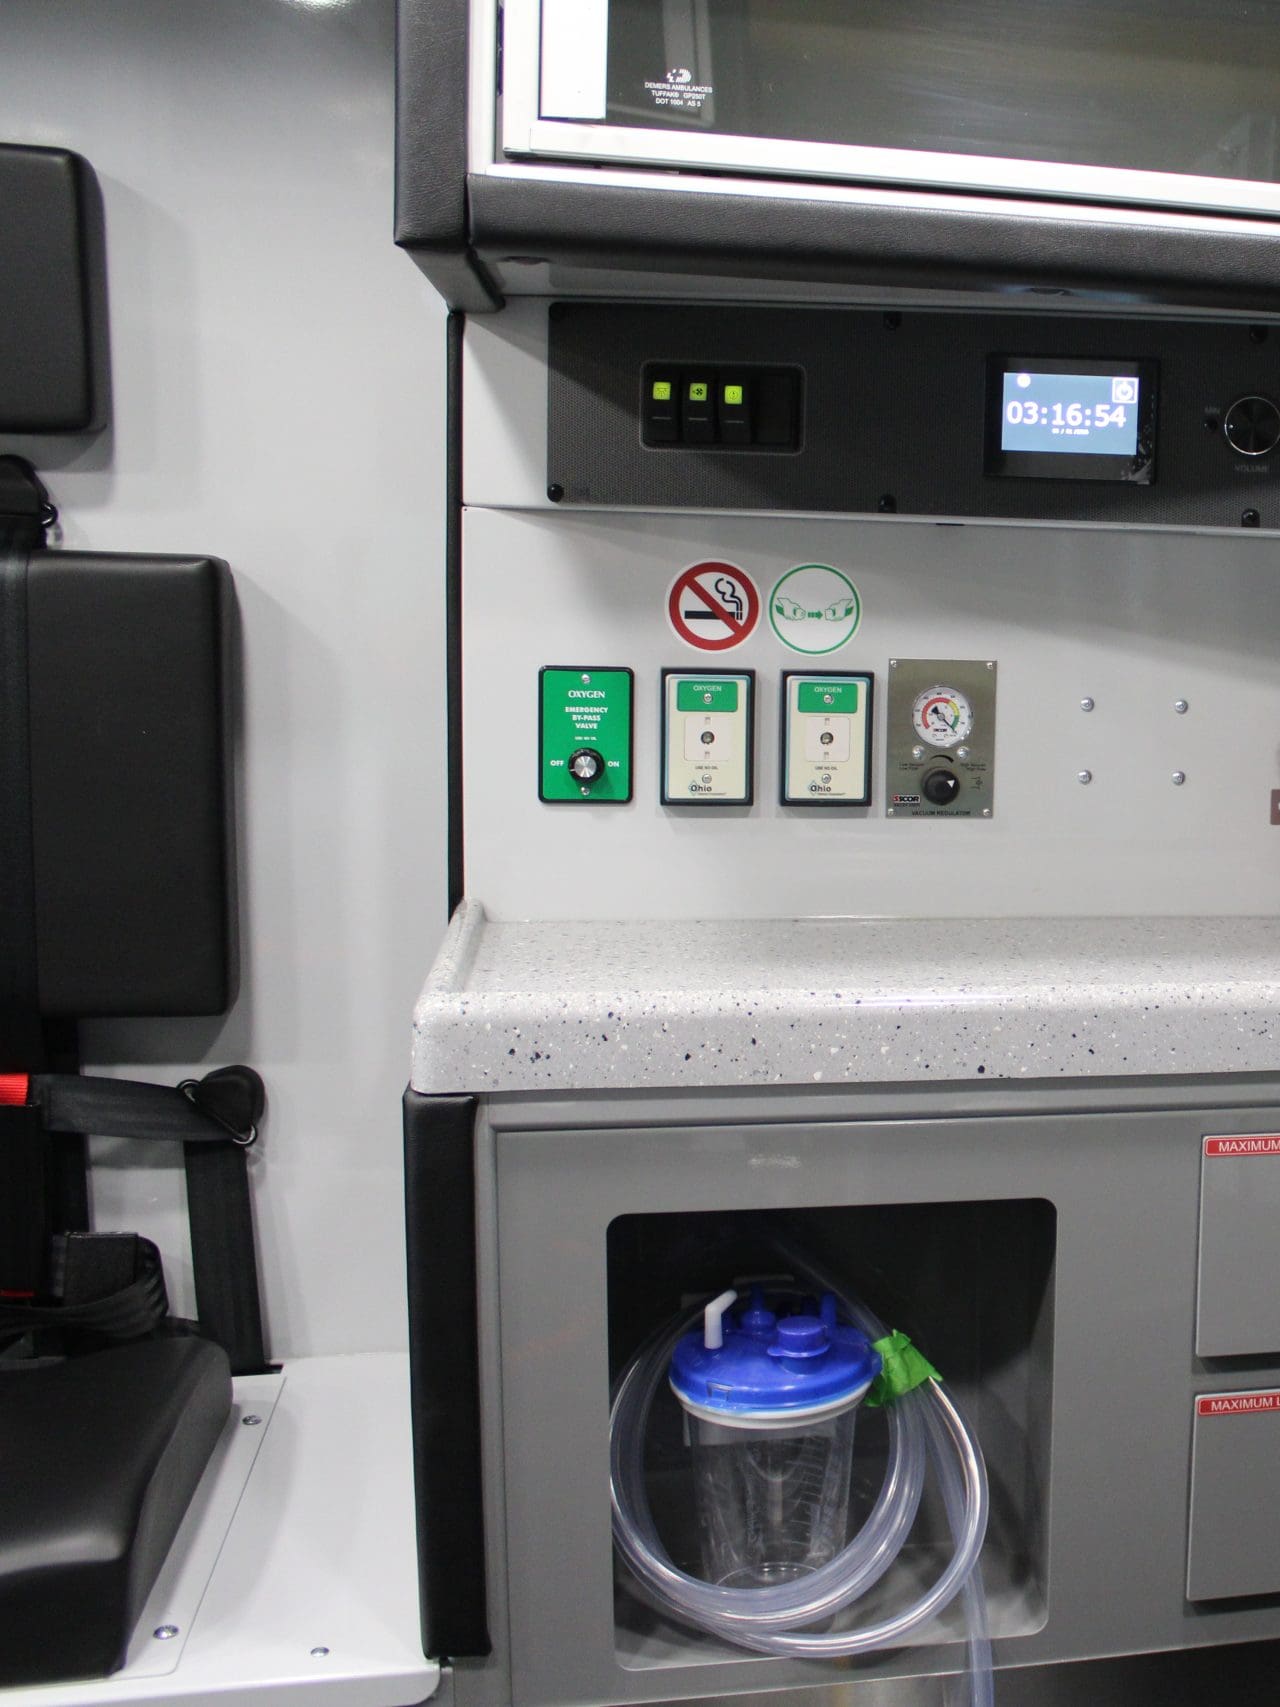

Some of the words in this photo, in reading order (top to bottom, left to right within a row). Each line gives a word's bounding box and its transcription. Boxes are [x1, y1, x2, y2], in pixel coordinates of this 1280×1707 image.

[644, 81, 671, 90] DEMERS
[671, 83, 713, 93] AMBULANCES
[655, 97, 669, 105] DOT
[1006, 401, 1127, 428] 03:16:54
[568, 690, 605, 699] OXYGEN
[565, 706, 608, 714] EMERGENCY
[572, 714, 601, 722] BY-PASS
[575, 722, 598, 730] VALVE
[690, 784, 712, 792] Ohio
[810, 784, 832, 792] Ohio
[1211, 1397, 1273, 1412] MAXIMUM
